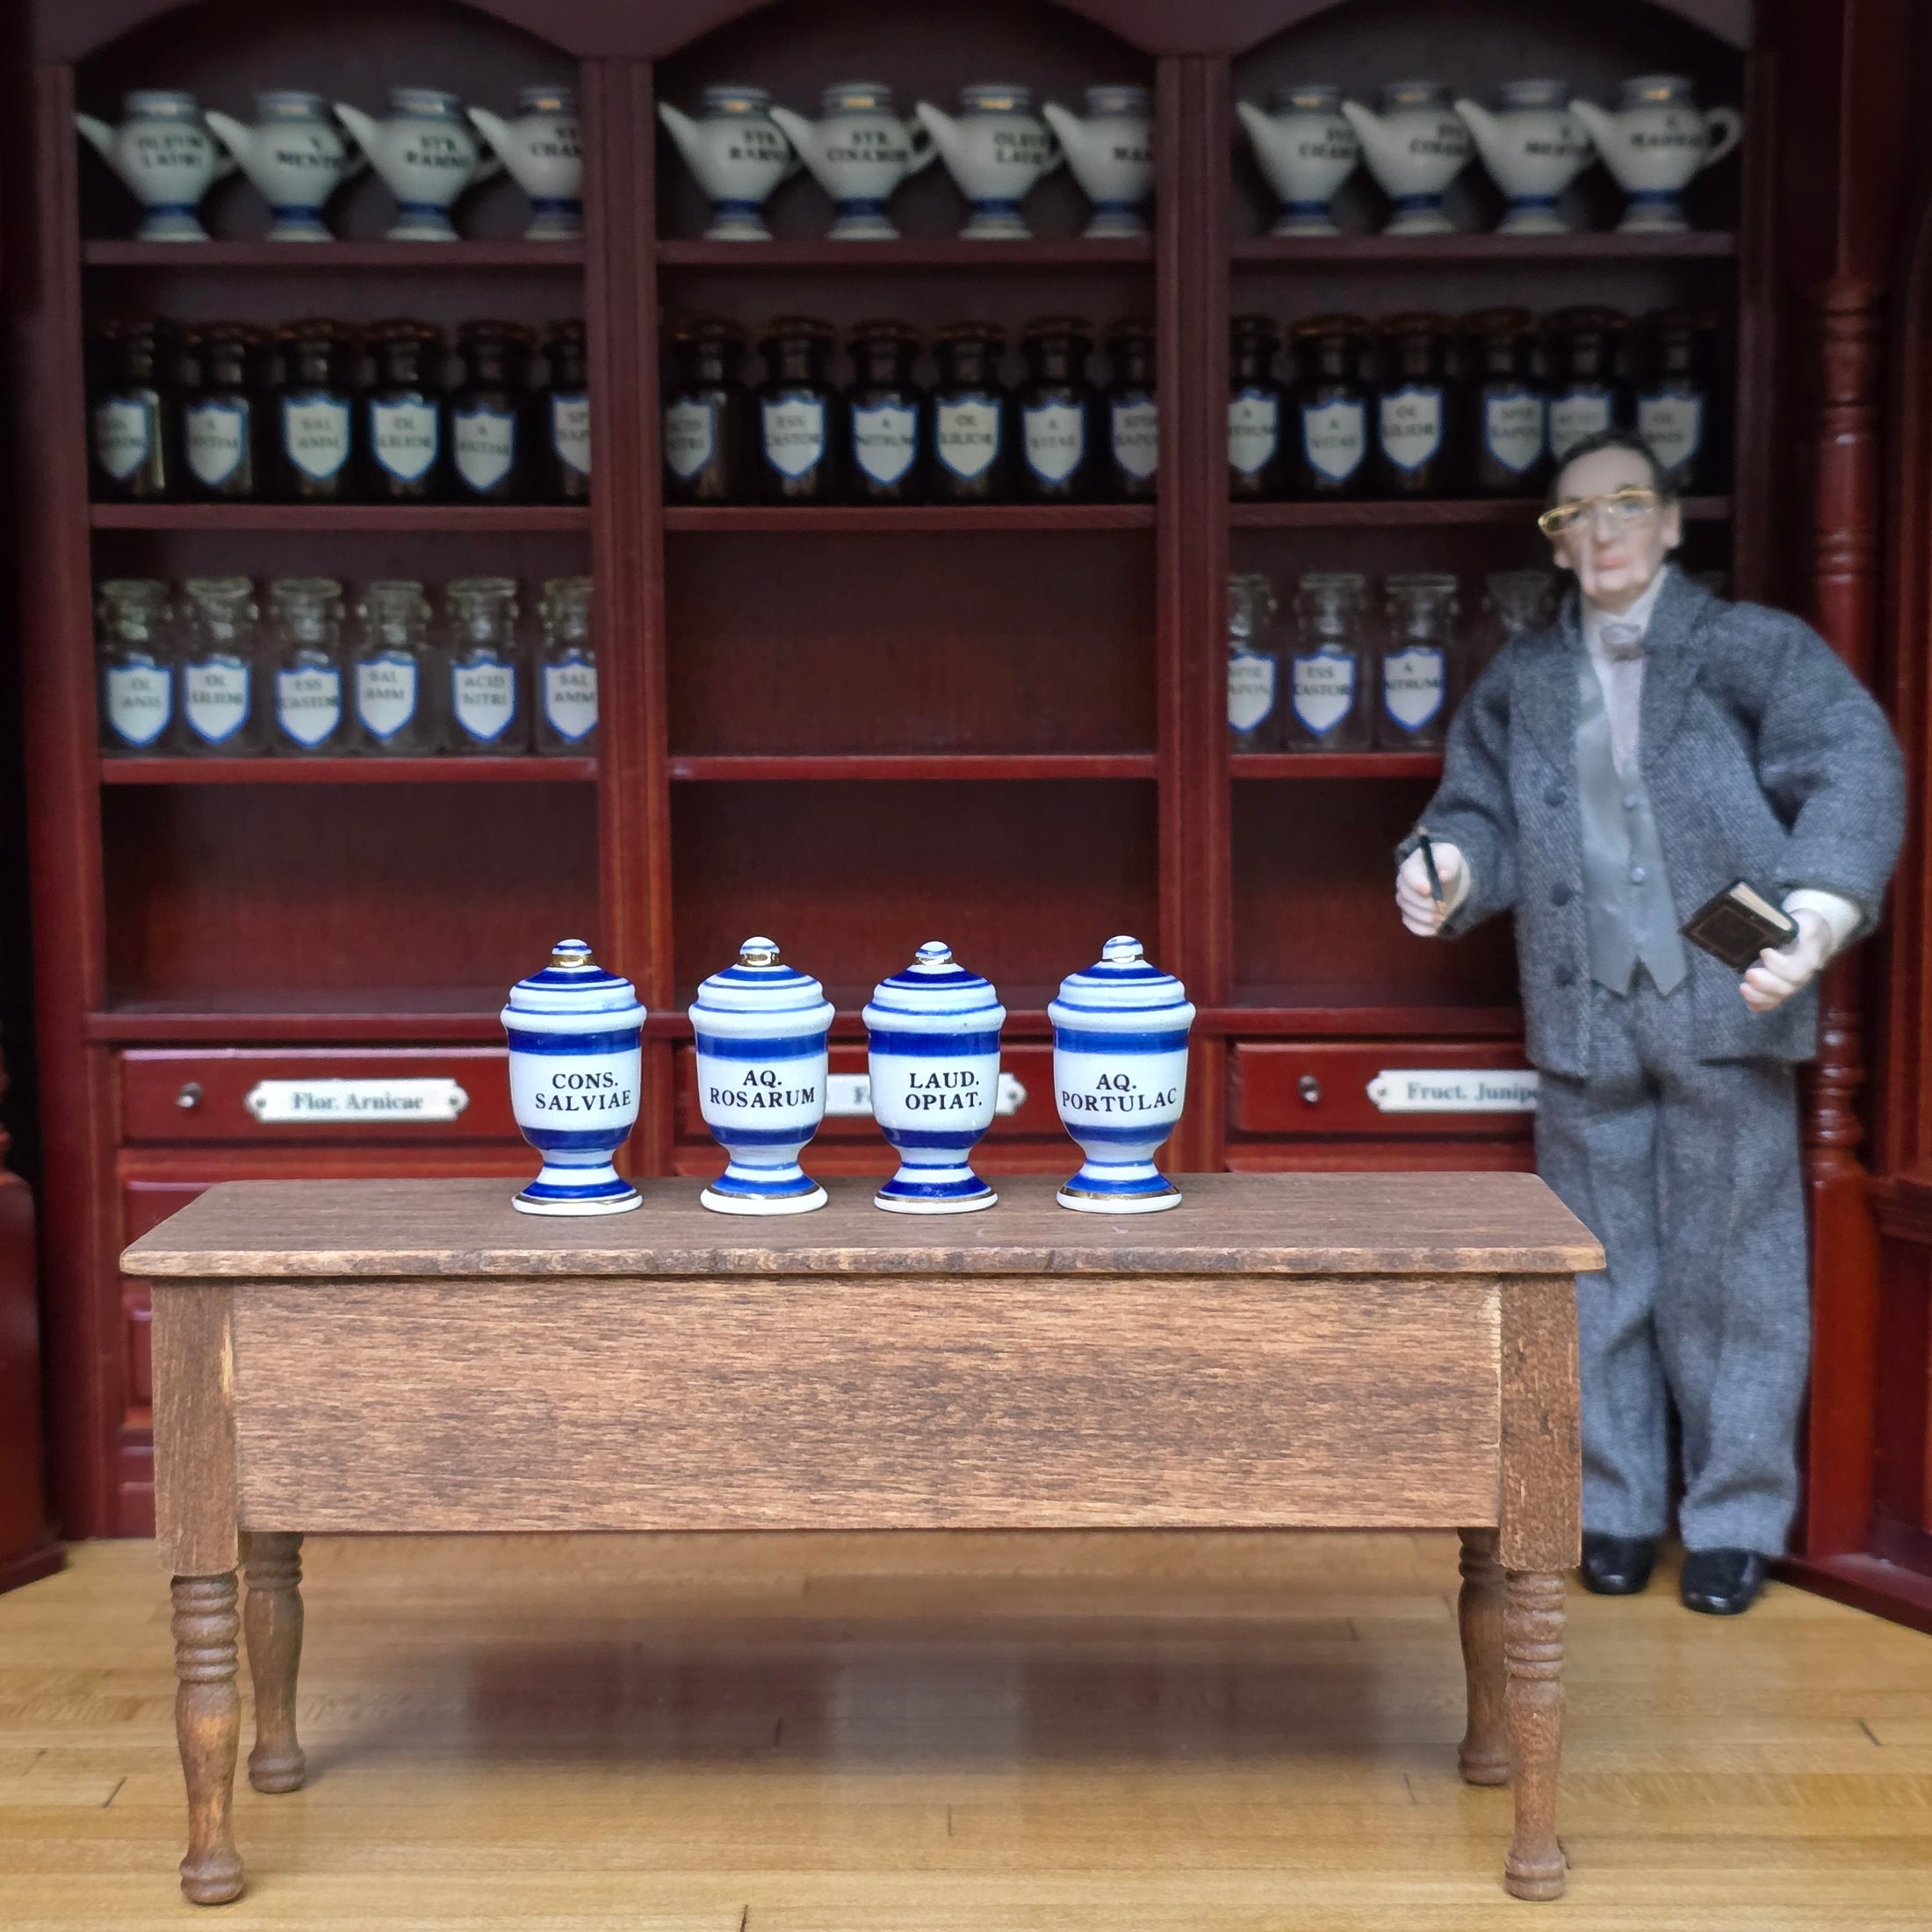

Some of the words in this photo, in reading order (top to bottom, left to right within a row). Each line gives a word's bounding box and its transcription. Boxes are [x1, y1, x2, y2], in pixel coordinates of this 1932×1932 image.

[552, 1071, 618, 1090] CONS.
[742, 1070, 782, 1089] AQ.
[909, 1071, 979, 1089] LAUD.
[1096, 1073, 1136, 1092] AQ.
[344, 1091, 424, 1110] Arnicae
[535, 1089, 631, 1112] SALVIAE
[710, 1086, 815, 1108] ROSARUM
[905, 1092, 983, 1111] OPIAT.
[1061, 1087, 1178, 1113] PORTULAC
